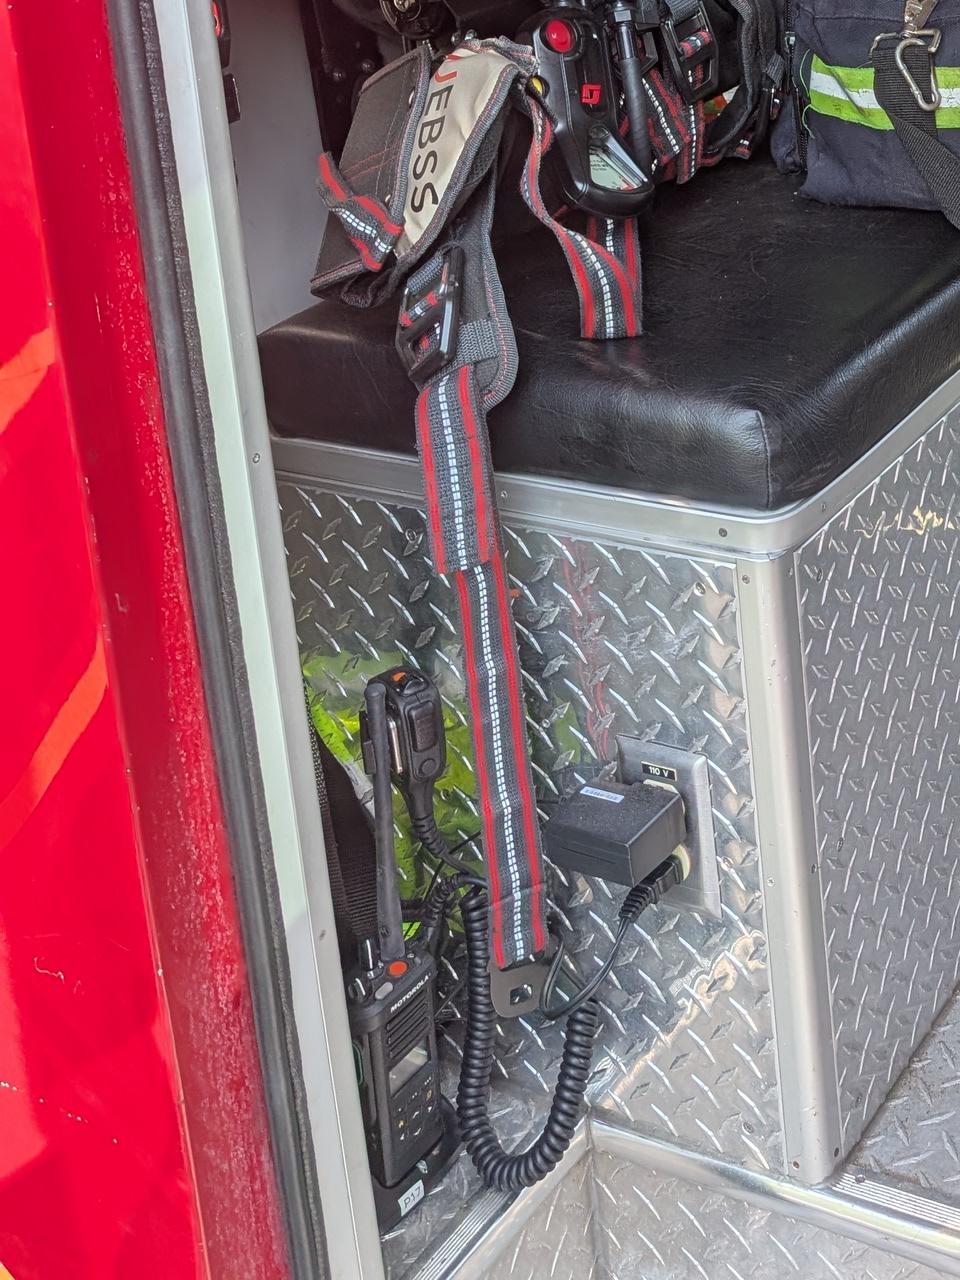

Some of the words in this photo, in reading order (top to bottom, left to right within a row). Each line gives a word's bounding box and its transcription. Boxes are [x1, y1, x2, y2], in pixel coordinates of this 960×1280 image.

[648, 766, 660, 775] 110
[663, 769, 669, 778] V
[390, 974, 429, 1013] MOTOROLA
